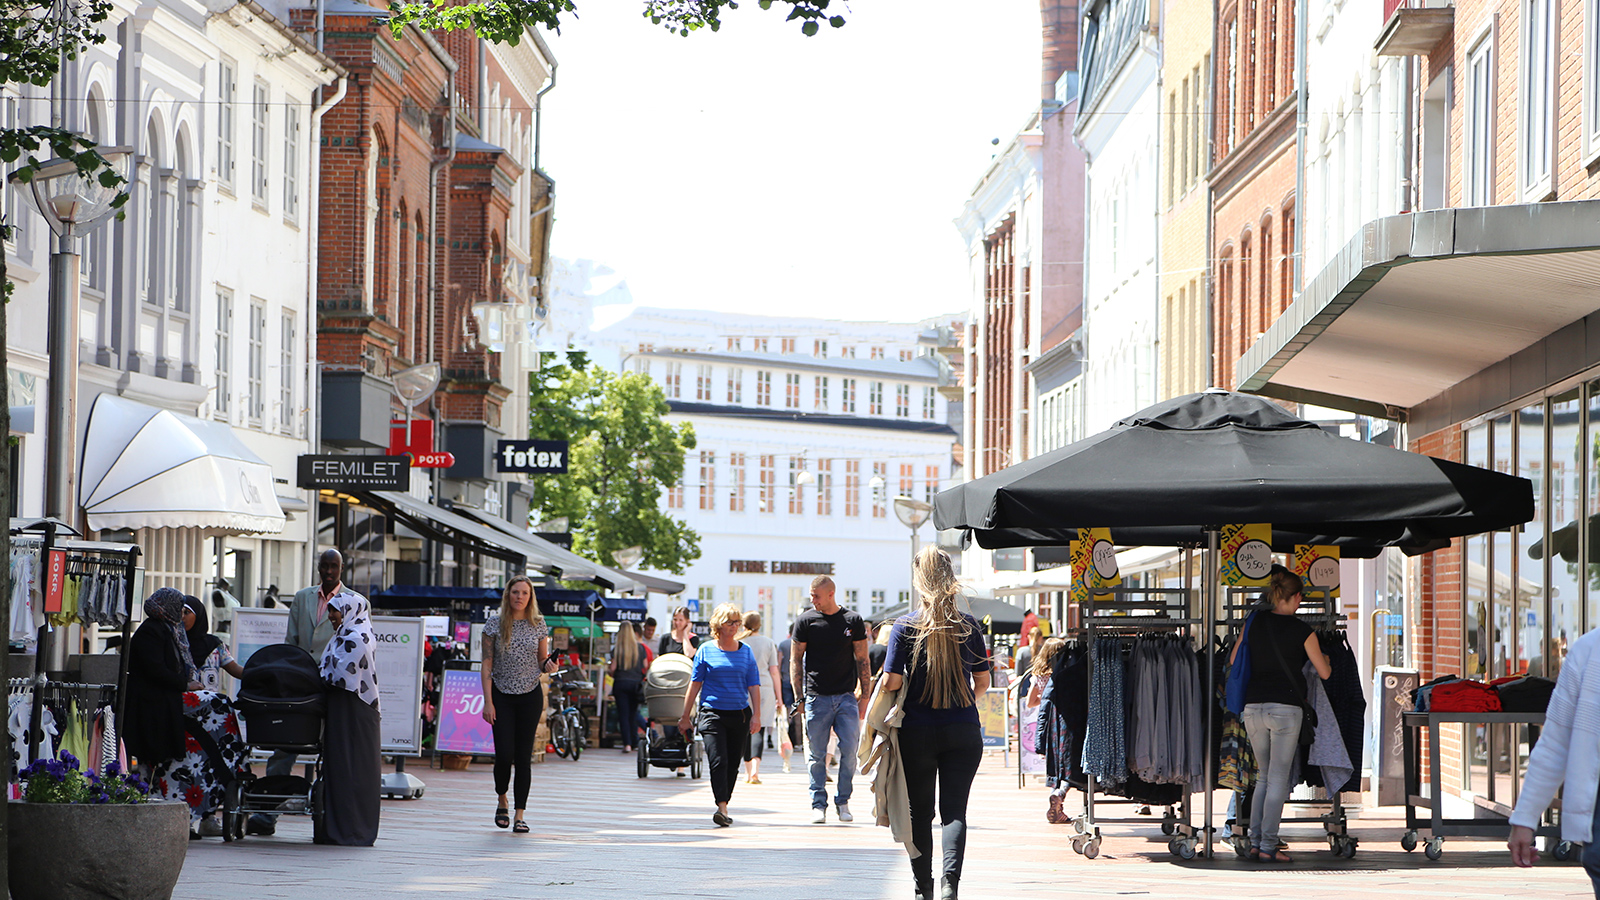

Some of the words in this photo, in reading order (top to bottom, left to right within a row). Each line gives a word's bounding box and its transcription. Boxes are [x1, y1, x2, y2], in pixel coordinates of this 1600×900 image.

[419, 455, 446, 464] POST
[502, 445, 562, 468] føtex
[312, 461, 401, 476] FEMILET
[1221, 532, 1249, 560] SALE
[1295, 550, 1320, 575] SALE
[692, 623, 709, 634] tex
